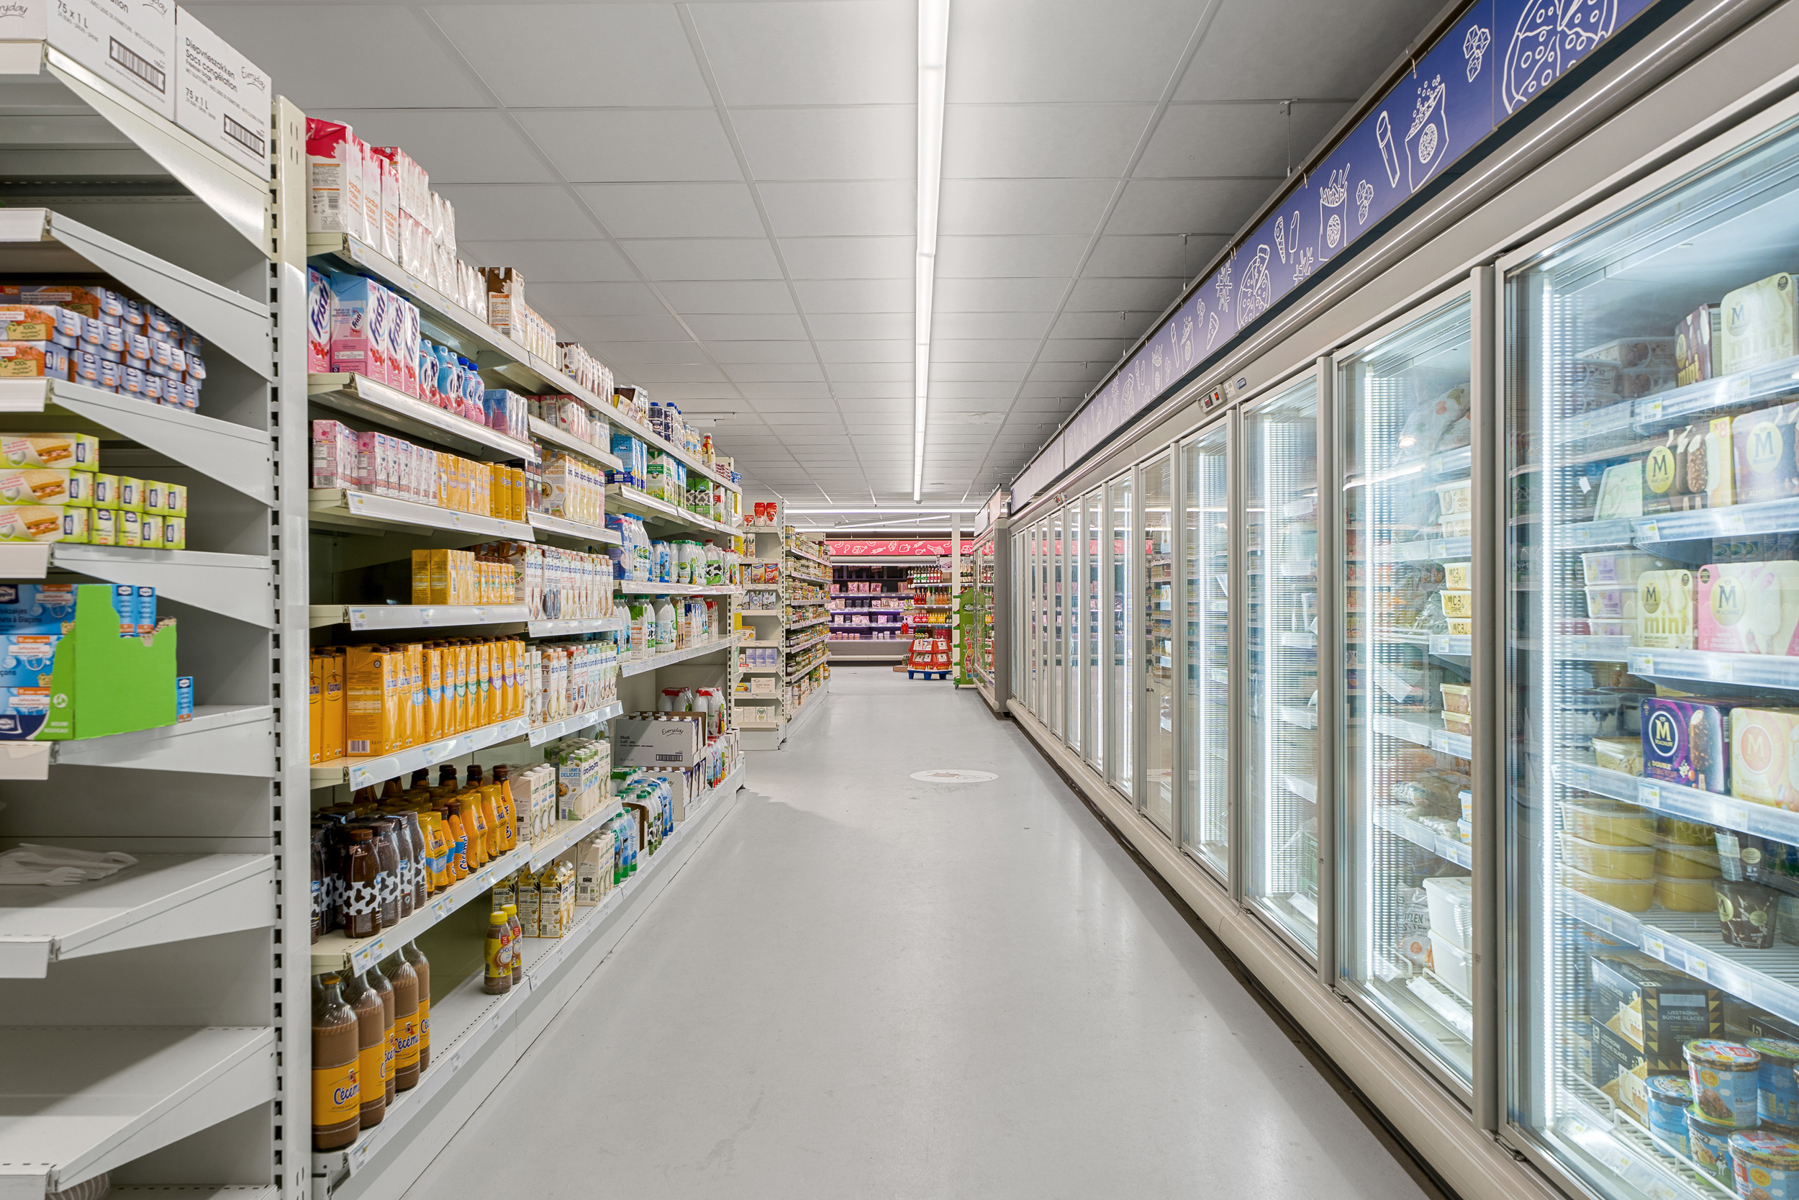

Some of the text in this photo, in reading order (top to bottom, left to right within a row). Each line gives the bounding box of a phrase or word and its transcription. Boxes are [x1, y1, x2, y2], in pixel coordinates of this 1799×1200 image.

[185, 49, 202, 67] Sacs
[311, 276, 330, 340] Fristi
[351, 311, 363, 329] Fristi
[370, 286, 386, 347] Fristi
[1754, 430, 1775, 458] M
[1652, 454, 1668, 478] M
[1645, 586, 1657, 603] M
[1718, 584, 1737, 609] M
[1644, 610, 1687, 635] mini
[1655, 720, 1670, 741] M
[1747, 734, 1764, 757] M
